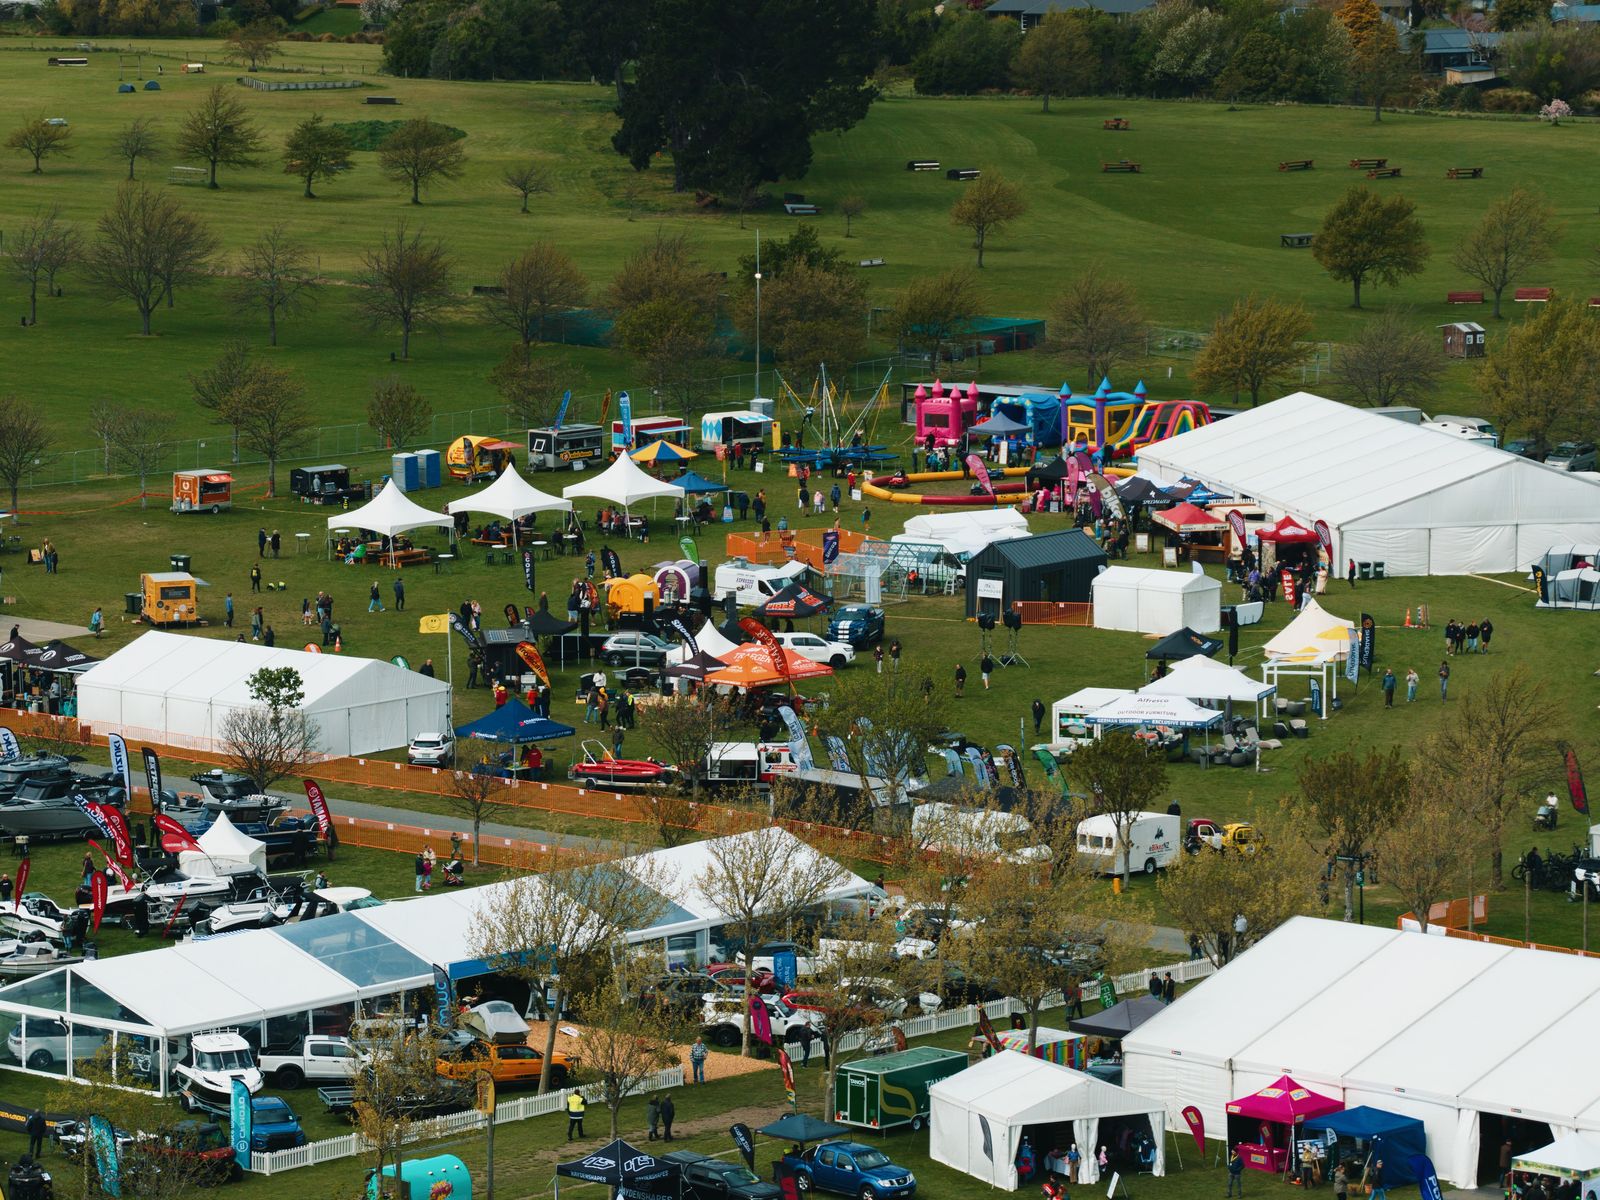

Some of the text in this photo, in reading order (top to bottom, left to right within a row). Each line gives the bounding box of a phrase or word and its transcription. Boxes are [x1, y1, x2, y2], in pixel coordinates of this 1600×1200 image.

[733, 652, 772, 664] TREGER
[755, 629, 784, 671] TRAEGER
[1101, 985, 1115, 1009] FIRS
